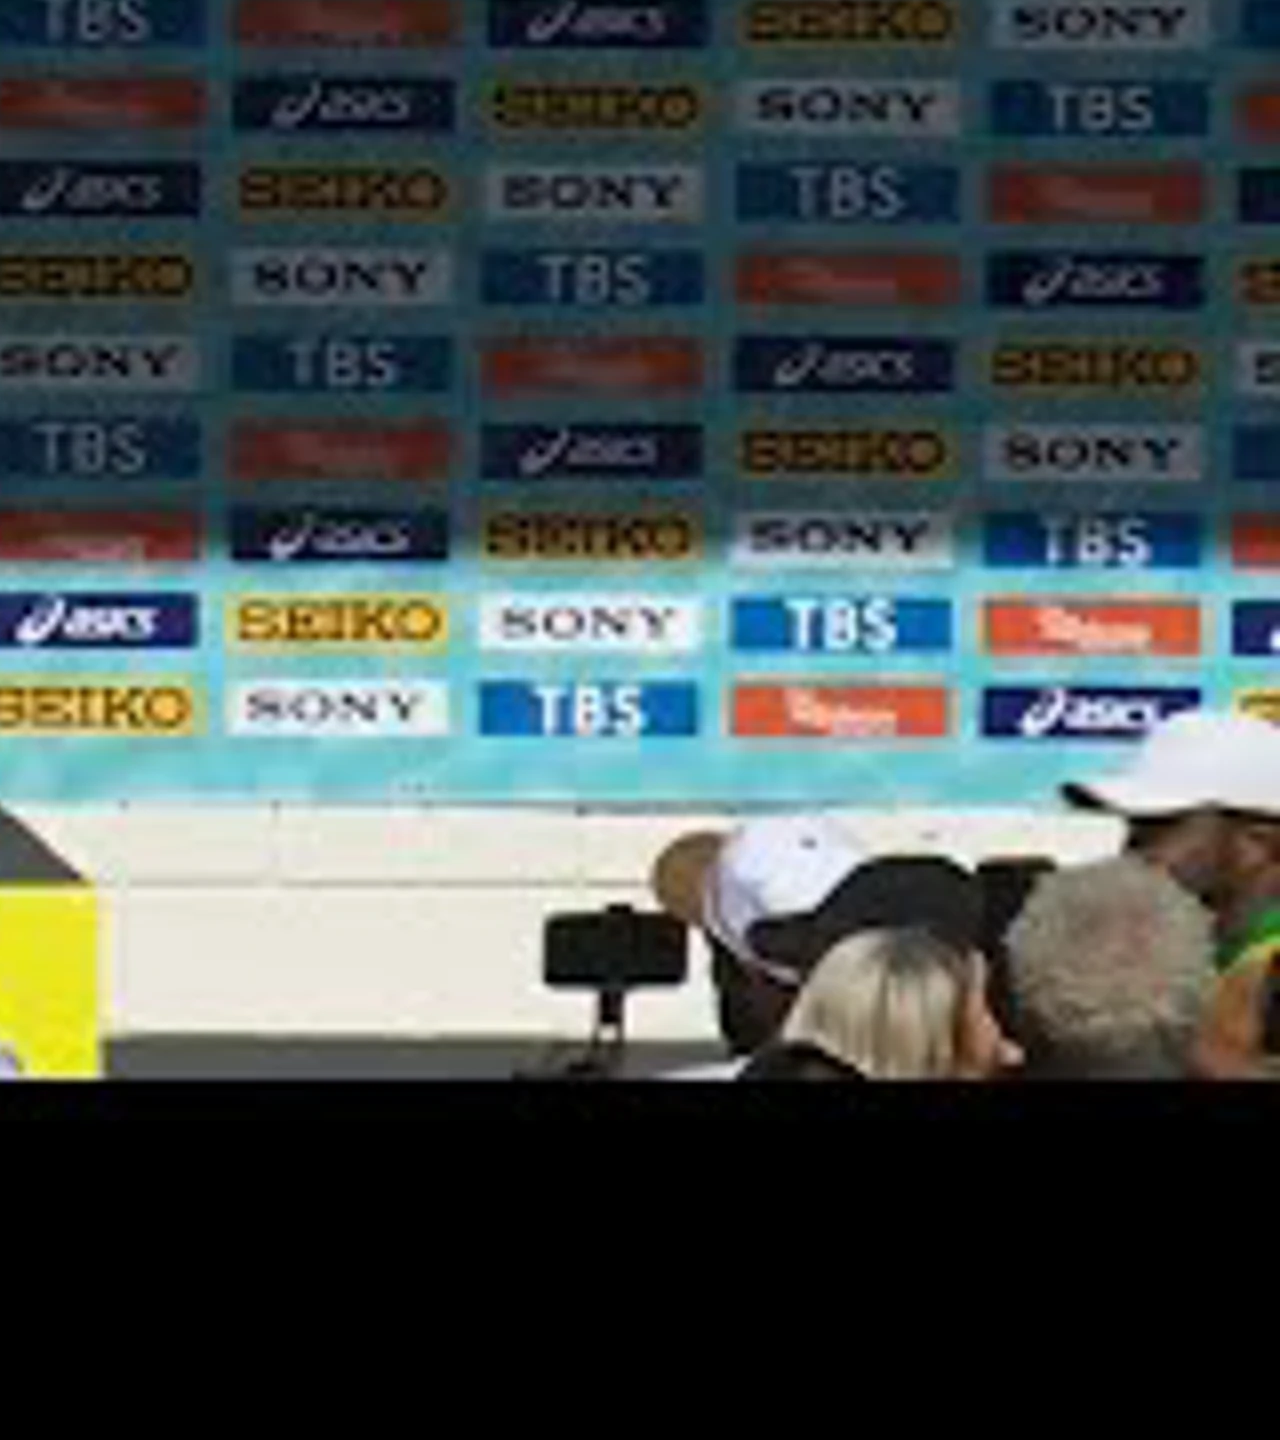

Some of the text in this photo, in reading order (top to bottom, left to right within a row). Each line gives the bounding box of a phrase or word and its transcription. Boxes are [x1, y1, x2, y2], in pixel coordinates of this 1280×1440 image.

[1008, 4, 1187, 38] SONY
[493, 84, 700, 127] SEIKO
[756, 88, 935, 122] SONY
[1041, 84, 1158, 134] TBS
[238, 167, 445, 210] SEIKO
[503, 174, 682, 208] SONY
[789, 168, 906, 218] TBS
[250, 259, 429, 293] SONY
[535, 253, 652, 303] TBS
[0, 344, 178, 378] SONY
[285, 339, 402, 389] TBS
[33, 423, 150, 473] TBS
[739, 430, 946, 473] SEIKO
[1001, 435, 1180, 469] SONY
[485, 512, 692, 555] SEIKO
[749, 521, 928, 555] SONY
[1036, 514, 1153, 564] TBS
[234, 598, 441, 641] SEIKO
[497, 604, 676, 638] SONY
[784, 599, 901, 649] TBS
[245, 689, 424, 723] SONY
[532, 684, 649, 734] TBS
